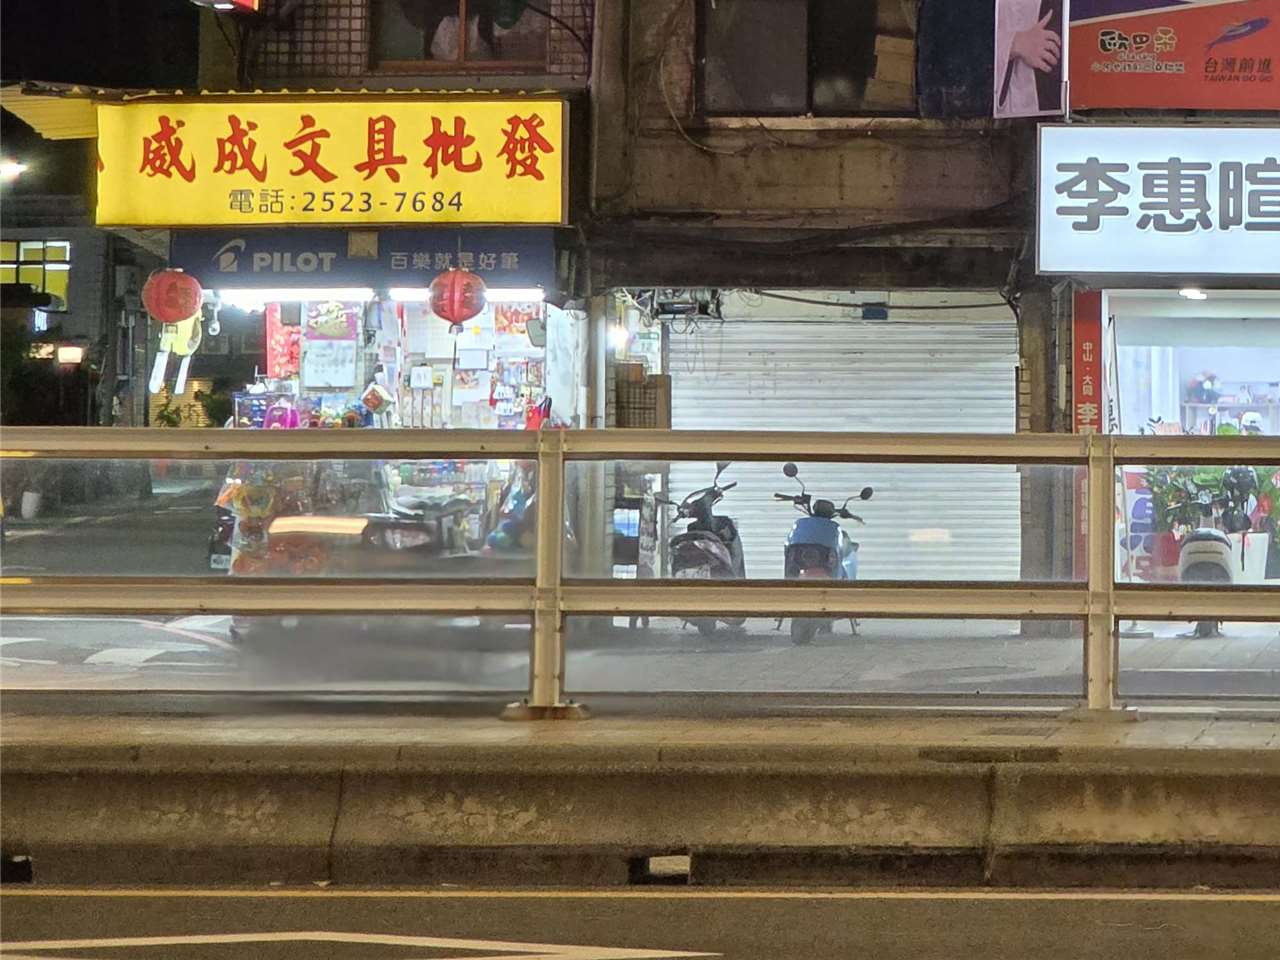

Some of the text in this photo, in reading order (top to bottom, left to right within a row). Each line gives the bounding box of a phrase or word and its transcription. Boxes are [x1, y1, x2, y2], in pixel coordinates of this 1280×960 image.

[139, 113, 554, 183] 威成文具批發
[253, 252, 337, 273] PILOT
